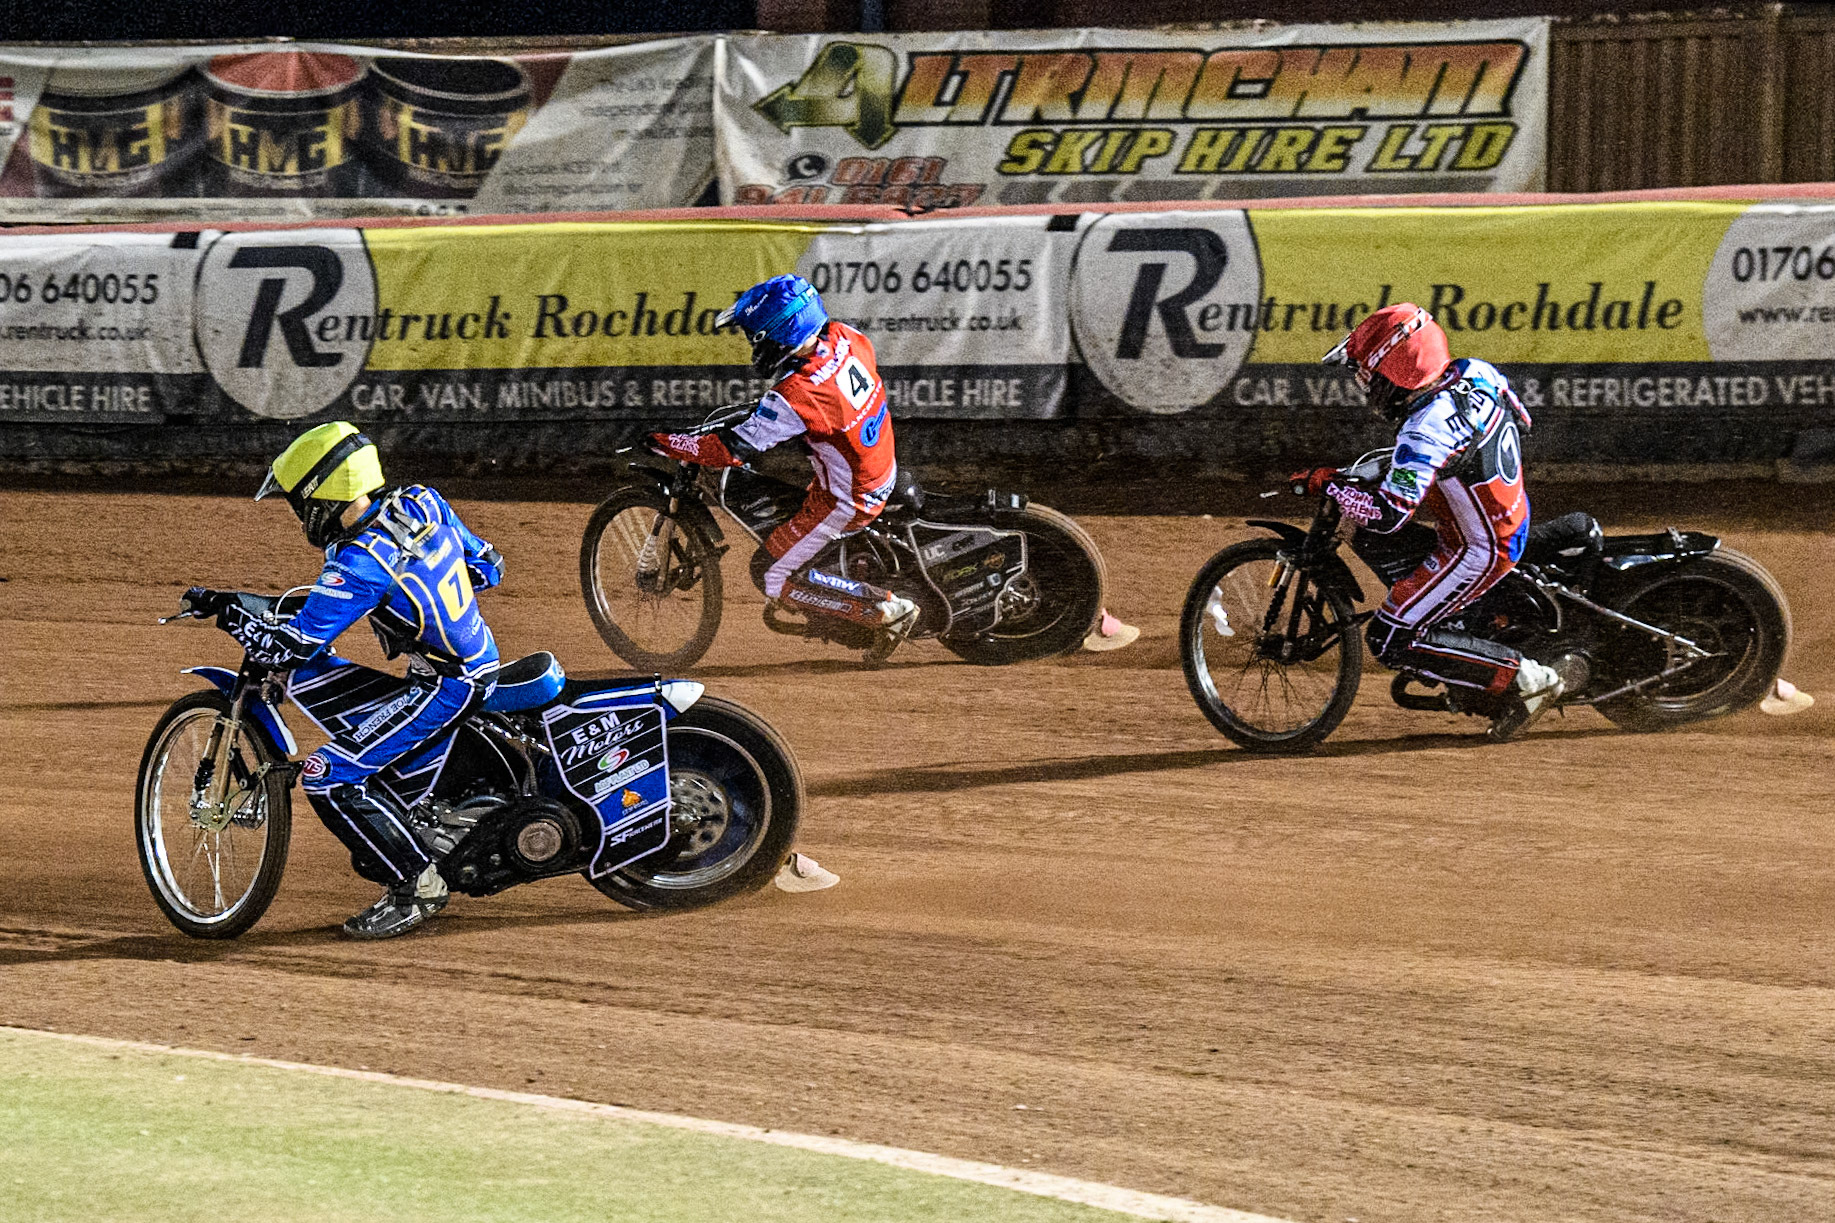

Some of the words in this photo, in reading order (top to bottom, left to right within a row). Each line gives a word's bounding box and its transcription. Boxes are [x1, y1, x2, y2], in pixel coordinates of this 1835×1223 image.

[997, 127, 1177, 175] SKIP
[1175, 125, 1369, 174] HIRE
[1366, 121, 1518, 174] LTD
[811, 261, 901, 294] 01706
[912, 259, 1032, 292] 640055
[1732, 246, 1835, 283] 01706
[41, 272, 159, 304] 640055
[227, 245, 511, 368] Rentruck
[529, 291, 745, 339] Rochda
[1430, 281, 1684, 332] Rochdale
[498, 381, 616, 409] MINIBUS
[622, 381, 643, 407] &
[651, 379, 775, 406] REFRIGE
[848, 364, 870, 397] 4
[883, 378, 955, 407] HICLE
[962, 377, 1022, 407] HIRE
[1522, 378, 1544, 406] &
[1552, 376, 1768, 407] REFRIGERATED
[1774, 375, 1835, 404] VEH
[90, 384, 151, 412] HIRE
[448, 570, 465, 610] 7
[355, 707, 392, 741] FRENCH
[560, 719, 645, 766] Motors
